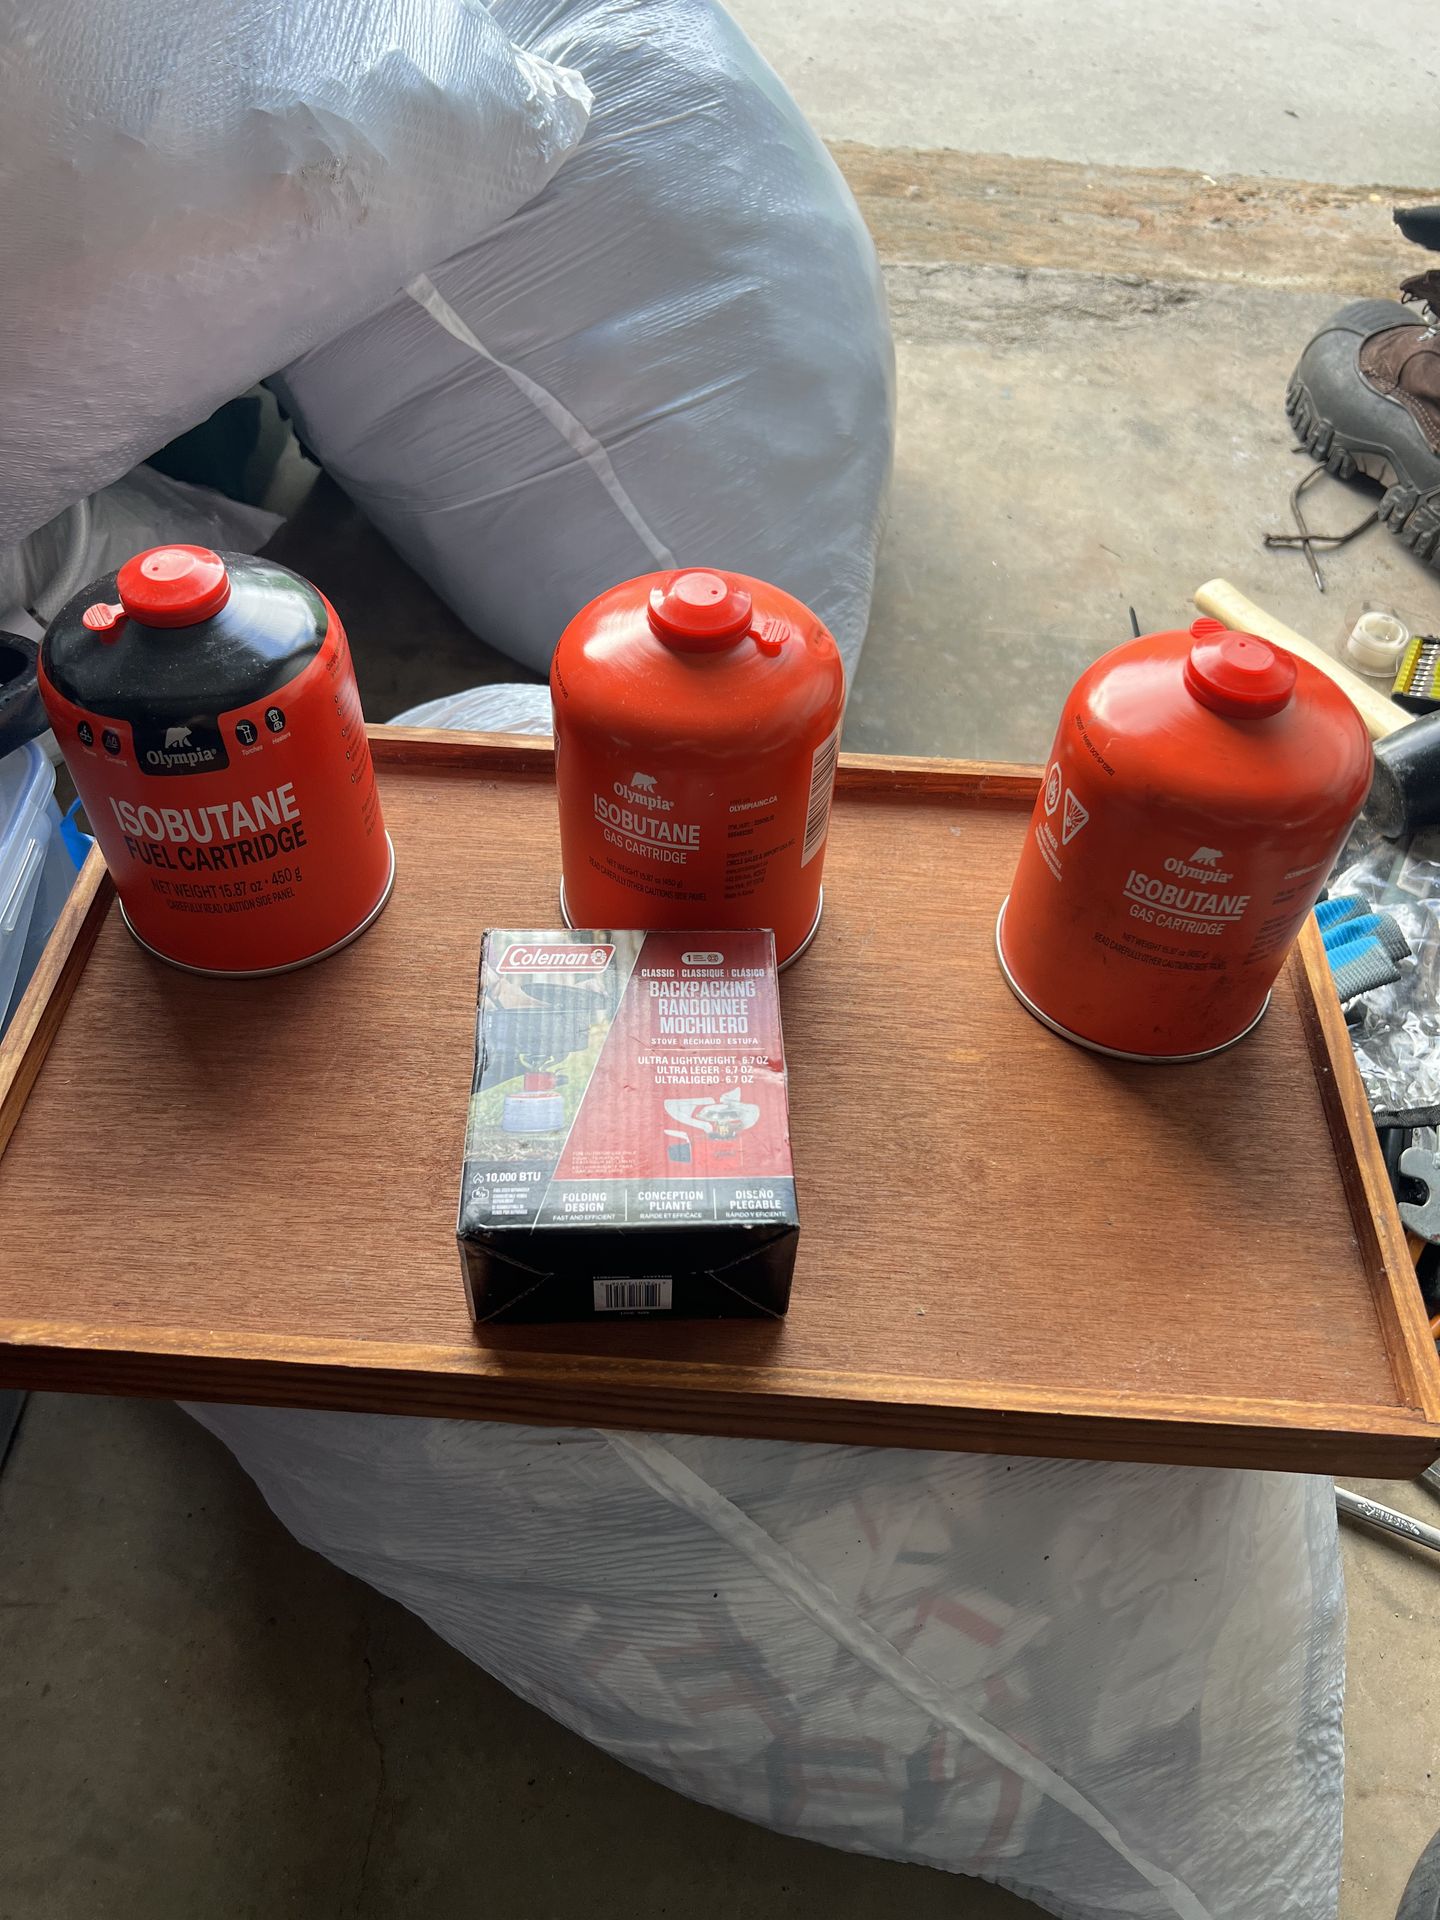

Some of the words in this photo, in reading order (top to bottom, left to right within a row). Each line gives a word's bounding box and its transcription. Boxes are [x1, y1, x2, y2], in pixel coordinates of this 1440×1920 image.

[146, 748, 214, 769] Olympia
[612, 781, 671, 811] Olympia
[729, 795, 778, 813] OLYMPIAINC.CA
[109, 782, 301, 844] ISOBUTANE
[593, 794, 701, 844] ISOBUTANE
[125, 836, 178, 871] FUEL
[178, 820, 308, 872] CARTRIDGE
[603, 827, 624, 849] GAS
[624, 838, 688, 865] CARTRIDGE
[616, 860, 639, 878] WEIGHT
[1164, 857, 1229, 885] Olympia
[151, 876, 171, 894] NET
[172, 883, 218, 899] WEIGHT
[219, 881, 247, 898] 15.87
[251, 880, 263, 893] oz
[272, 867, 292, 885] 450
[295, 866, 302, 882] g
[601, 865, 626, 886] CAREFULLY
[626, 879, 645, 893] OTHER
[645, 886, 674, 899] CAUTIONS
[203, 903, 224, 914] READ
[223, 901, 256, 913] CAUTION
[256, 897, 273, 908] SIDE
[272, 887, 296, 903] PANEL
[1125, 870, 1251, 915] ISOBUTANE
[1129, 903, 1155, 923] GAS
[1155, 911, 1226, 935] CARTRIDGE
[1094, 931, 1110, 947] READ
[509, 948, 589, 966] Coleman
[686, 955, 691, 963] 1
[641, 968, 675, 978] CLASSIC
[681, 968, 725, 978] CLASSIQUE
[731, 967, 765, 977] CLÁSICO
[649, 981, 756, 998] BACKPACKING
[658, 998, 749, 1016] RANDONNEE
[660, 1016, 748, 1034] MOCHILERO
[727, 1037, 759, 1045] ESTUFA
[638, 1056, 669, 1065] ULTRA
[671, 1055, 737, 1065] LIGHTWEIGHT
[741, 1056, 755, 1065] 6.7
[756, 1055, 769, 1065] OZ
[656, 1066, 688, 1075] ULTRA
[740, 1065, 754, 1075] OZ
[655, 1075, 720, 1085] ULTRALIGERO
[725, 1075, 738, 1084] 6.7
[740, 1075, 754, 1084] OZ
[485, 1172, 517, 1183] 10,000
[519, 1171, 542, 1182] BTU
[562, 1192, 608, 1203] FOLDING
[638, 1191, 704, 1201] CONCEPTION
[735, 1187, 774, 1200] DISEÑO
[564, 1202, 605, 1212] DESIGN
[649, 1201, 693, 1211] PLIANTE
[729, 1199, 782, 1210] PLEGABLE
[552, 1214, 570, 1222] FAST
[584, 1213, 616, 1221] EFFICIENT
[672, 1211, 702, 1219] EFFICACE
[755, 1210, 787, 1218] EFICIENTE
